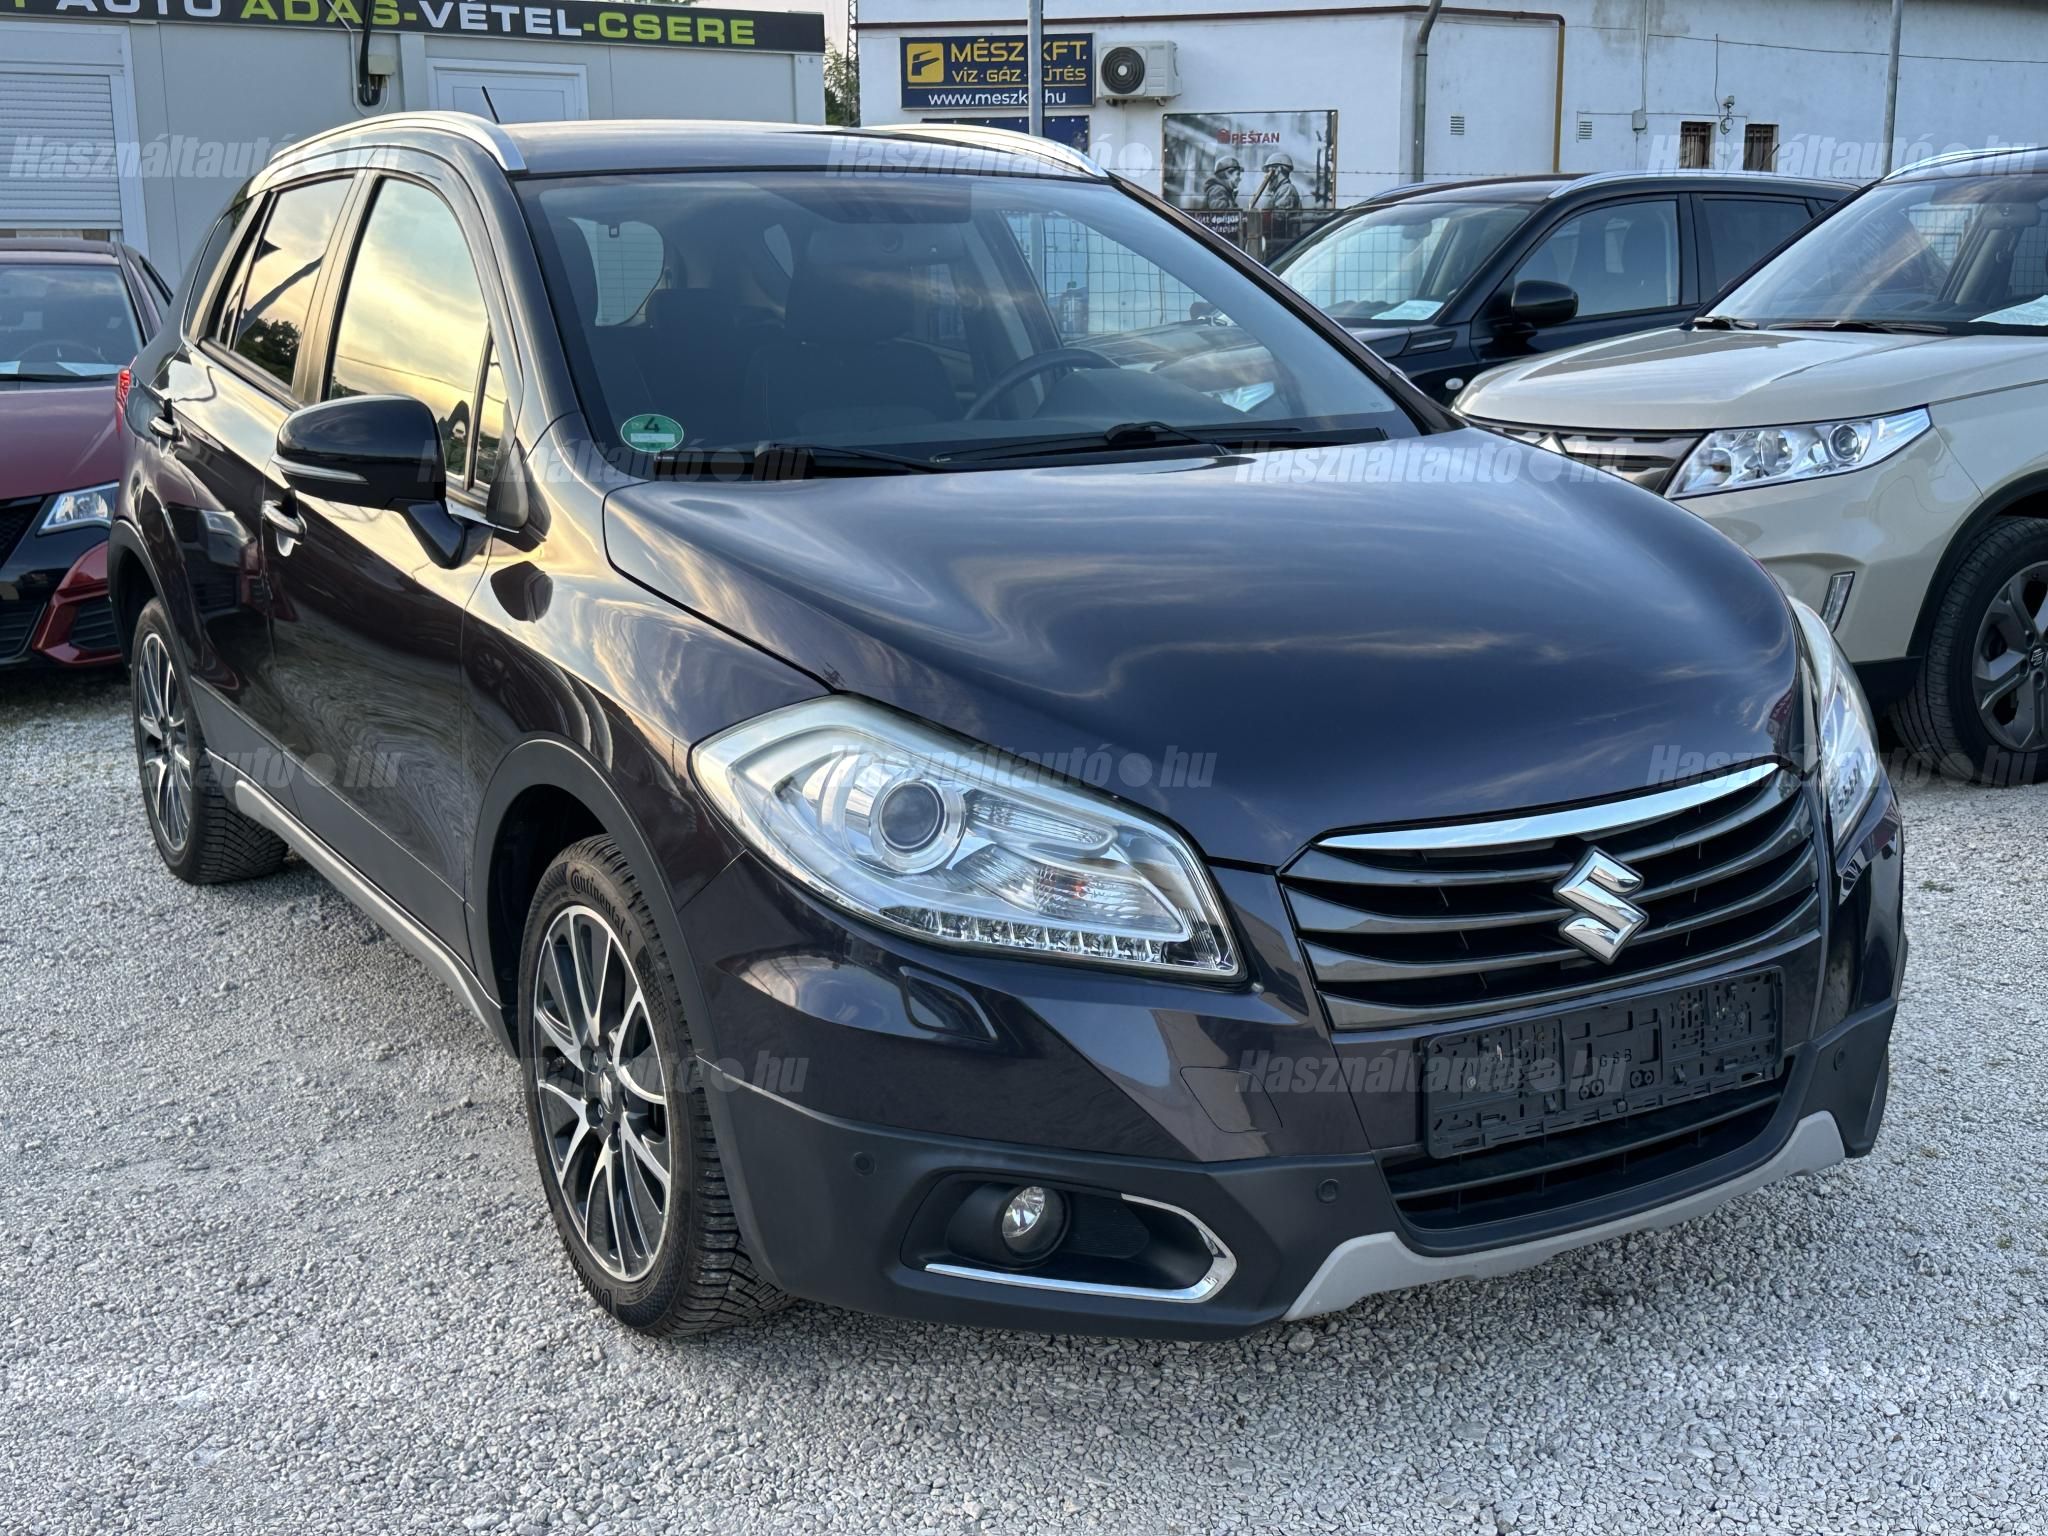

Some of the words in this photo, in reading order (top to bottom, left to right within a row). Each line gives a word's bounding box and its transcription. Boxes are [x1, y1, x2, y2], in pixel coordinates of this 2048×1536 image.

[950, 38, 1025, 63] MÉSZ
[952, 67, 979, 83] VÍZ
[986, 66, 1022, 82] GÁZ
[928, 88, 1067, 105] www.meszkhu
